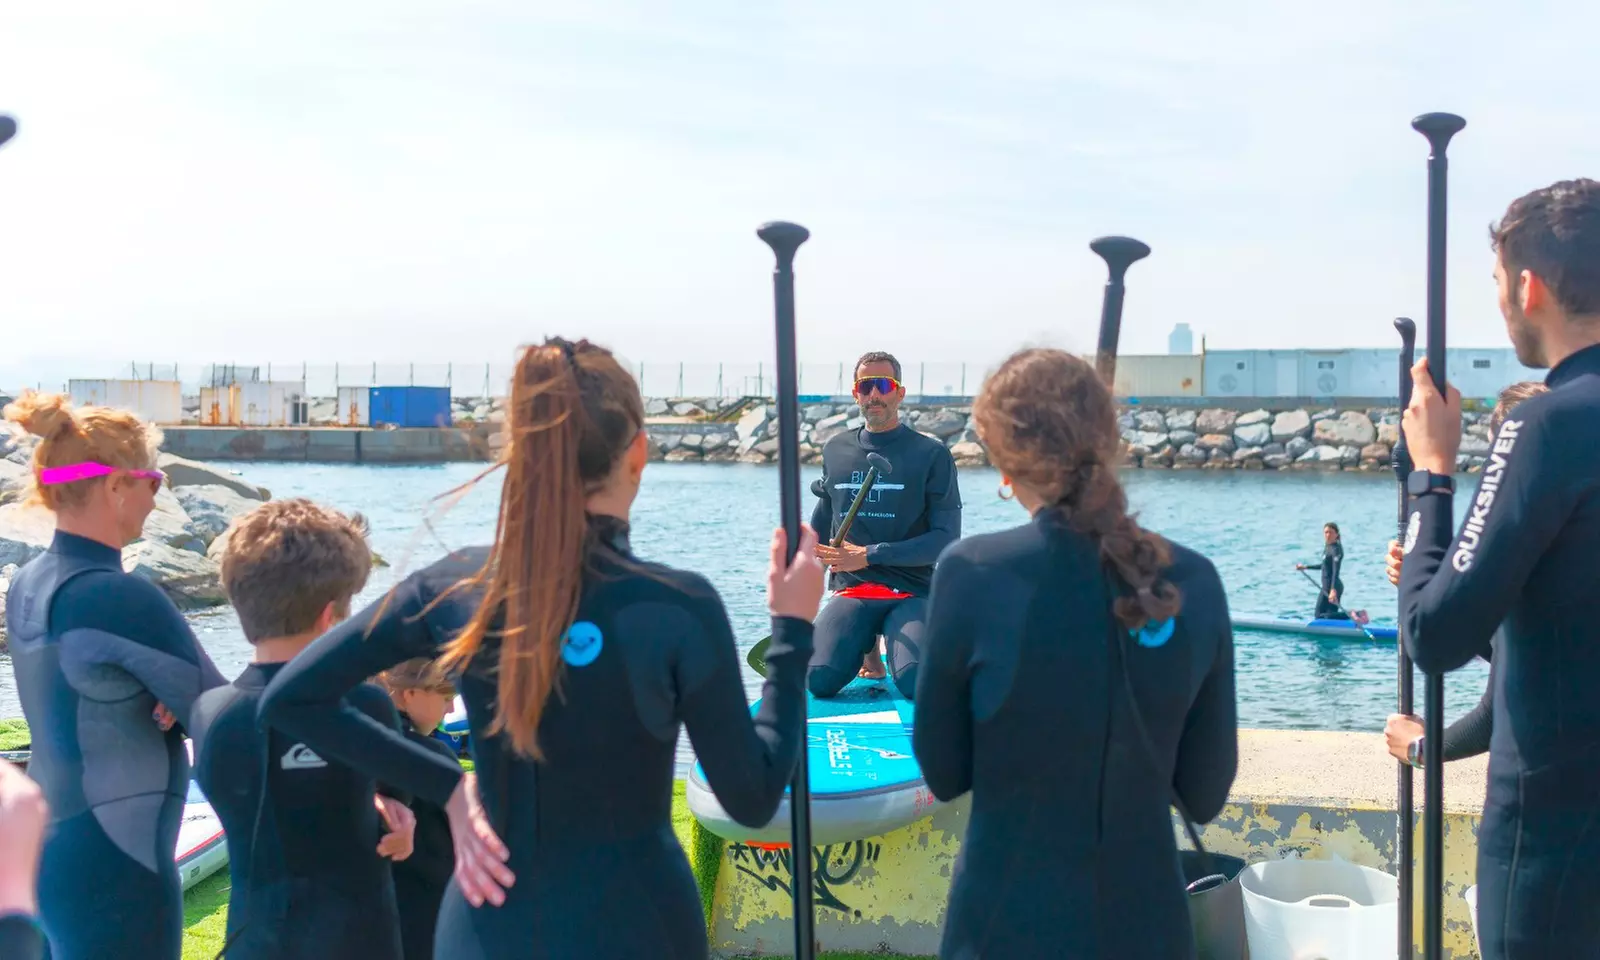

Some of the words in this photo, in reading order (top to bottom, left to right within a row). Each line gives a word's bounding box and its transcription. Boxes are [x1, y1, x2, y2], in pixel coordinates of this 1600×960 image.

[851, 470, 885, 484] BLE
[850, 488, 885, 503] SLT
[1453, 420, 1524, 572] QUIKSILVER
